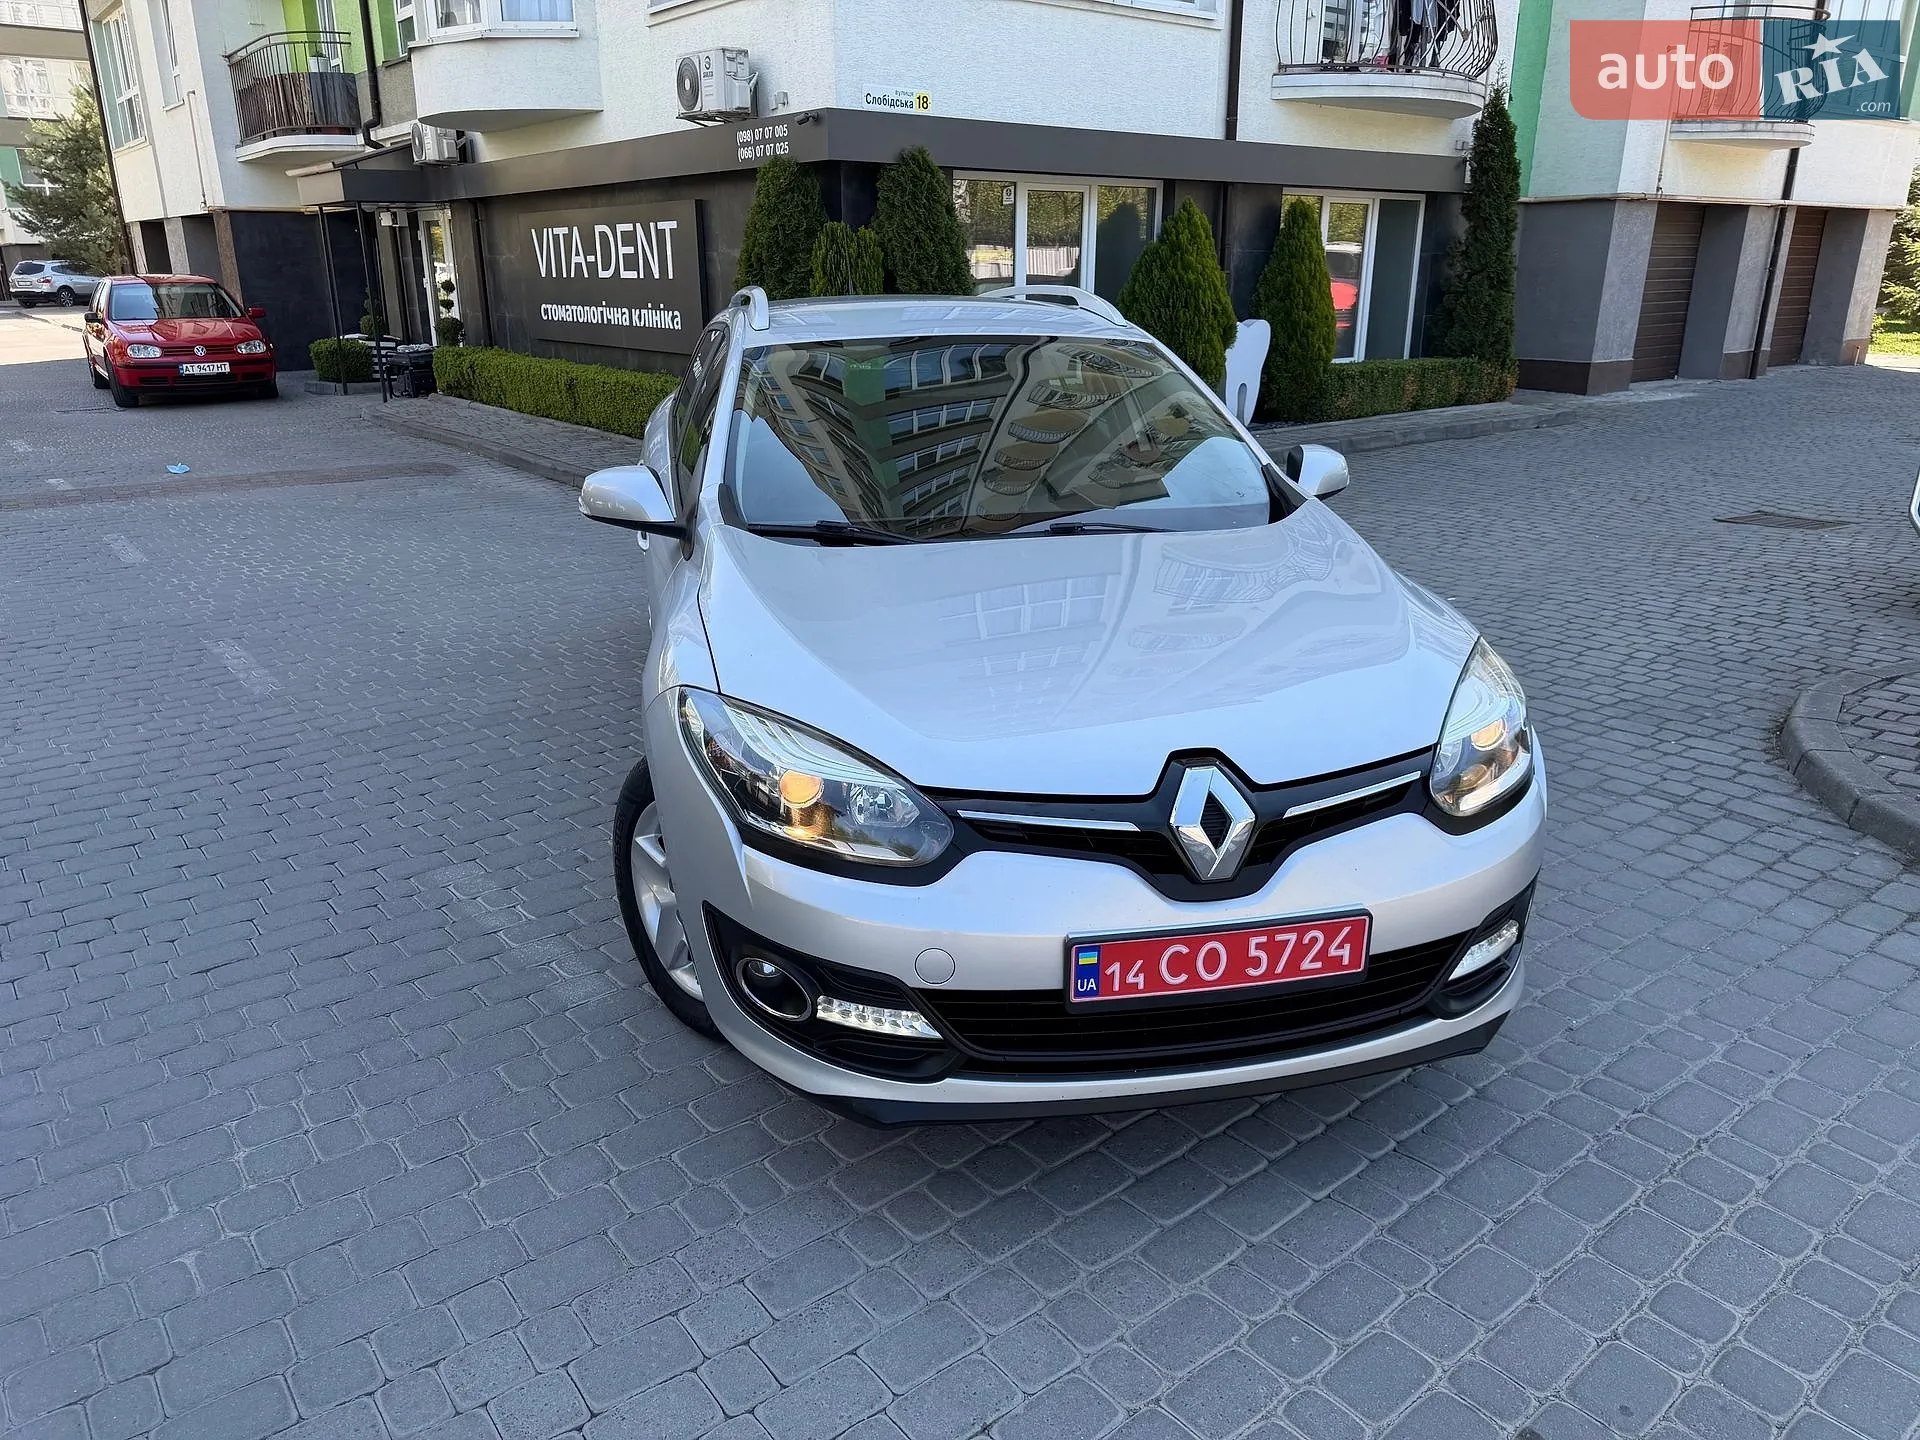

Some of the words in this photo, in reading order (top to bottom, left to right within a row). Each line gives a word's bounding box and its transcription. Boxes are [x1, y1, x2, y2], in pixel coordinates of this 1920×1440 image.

[865, 92, 914, 109] Слобідська
[916, 95, 929, 110] 18
[736, 129, 754, 147] (098)
[754, 127, 763, 141] 07
[764, 126, 773, 139] 07
[774, 123, 788, 138] 005
[738, 145, 755, 163] (066)
[755, 144, 764, 158] 07
[765, 143, 774, 157] 07
[775, 141, 789, 155] 025
[531, 220, 678, 280] VITA-DENT
[540, 300, 630, 327] стоматологічна
[631, 302, 682, 331] клініка
[185, 364, 195, 373] AT
[196, 363, 216, 373] 9417
[216, 363, 228, 372] HT
[1104, 958, 1145, 992] 14
[1158, 940, 1228, 986] CO
[1244, 925, 1353, 978] 5724
[1077, 978, 1098, 993] UA
